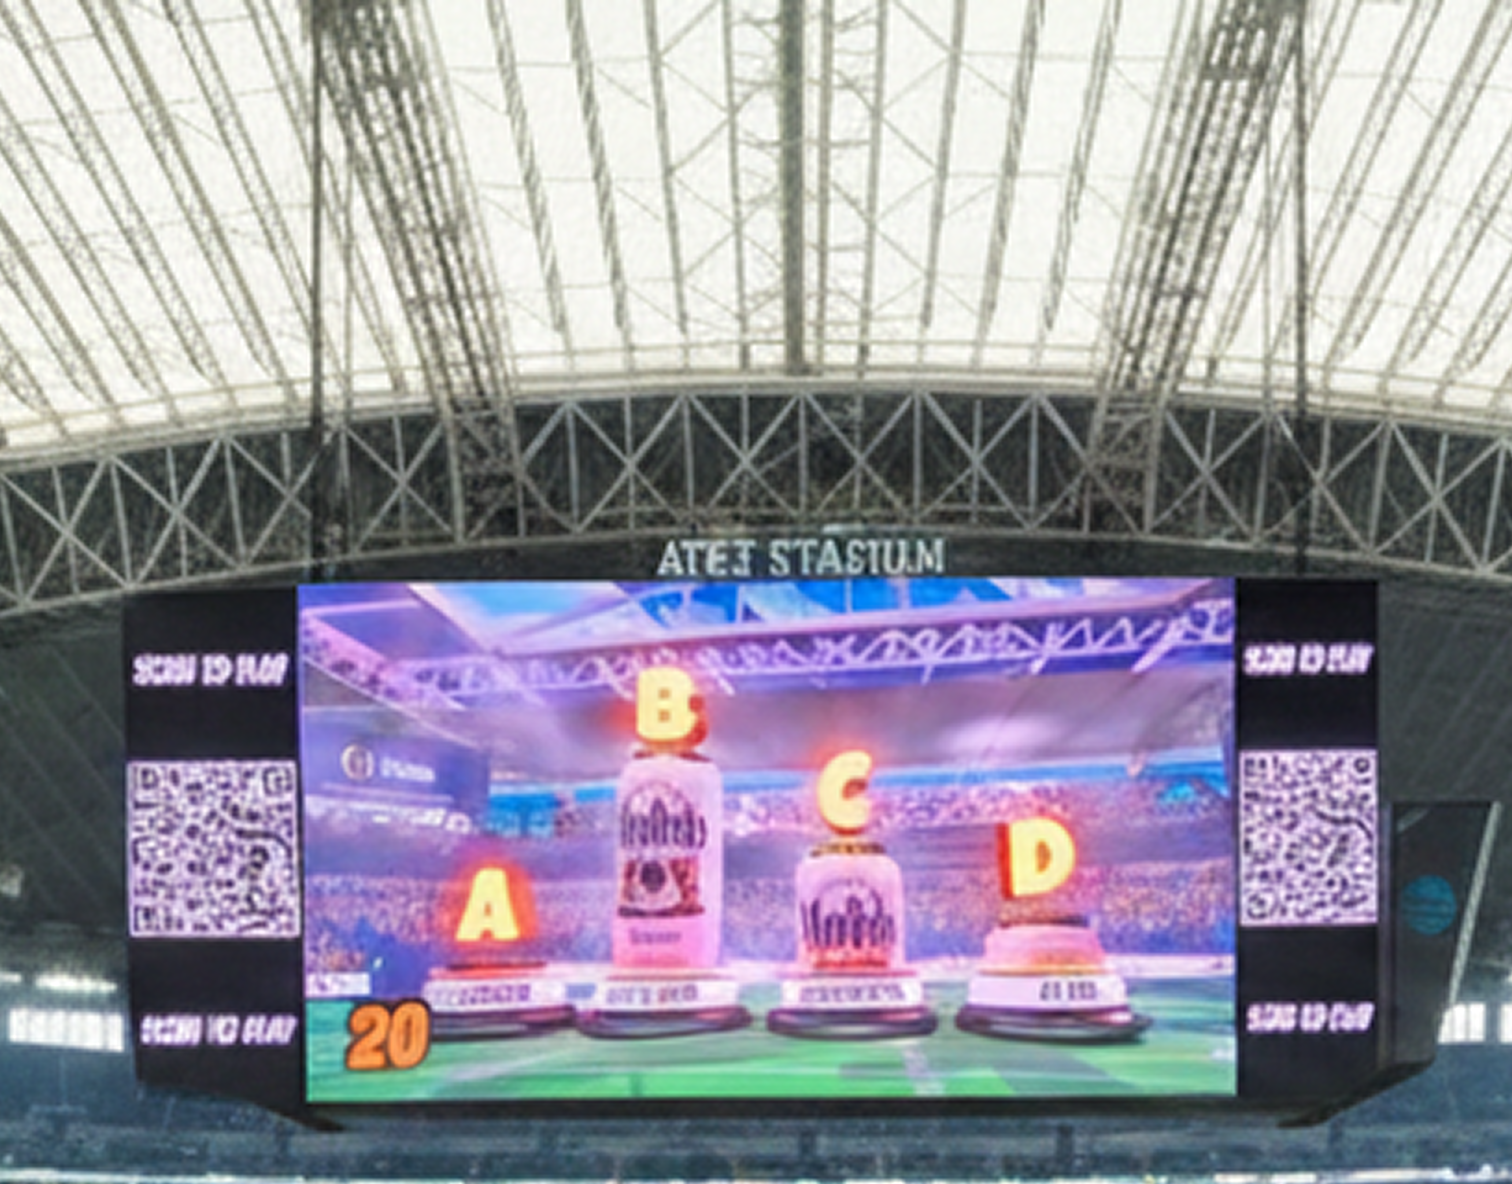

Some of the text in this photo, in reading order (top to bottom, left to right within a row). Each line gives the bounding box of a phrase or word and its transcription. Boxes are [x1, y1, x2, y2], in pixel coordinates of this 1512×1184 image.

[636, 666, 708, 742] B
[816, 749, 872, 834] C
[998, 817, 1075, 899] D
[454, 866, 522, 942] A
[344, 998, 432, 1073] 20
